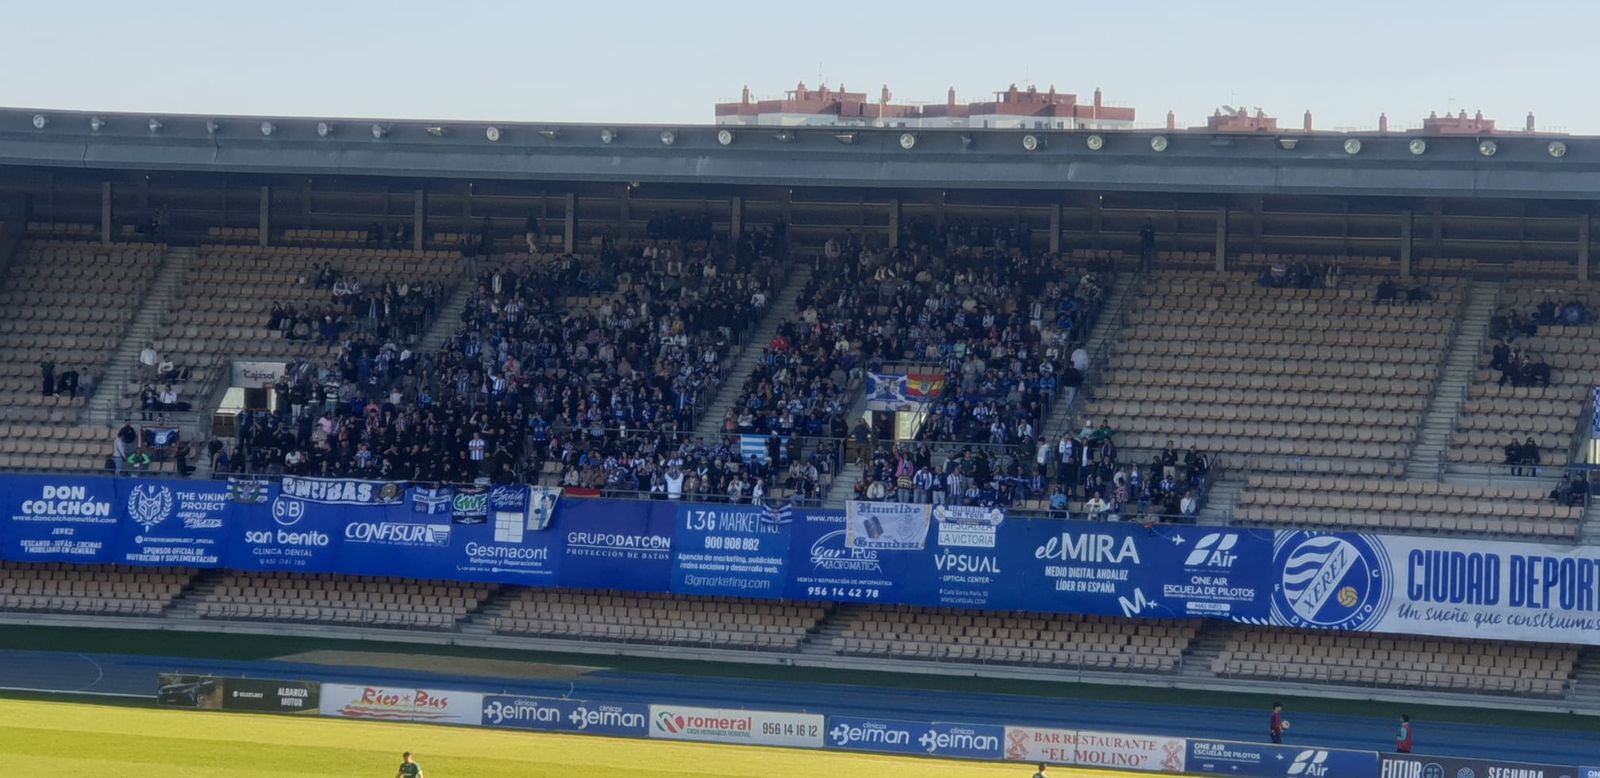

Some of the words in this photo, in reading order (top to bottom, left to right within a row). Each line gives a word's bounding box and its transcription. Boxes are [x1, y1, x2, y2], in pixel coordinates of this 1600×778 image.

[43, 486, 85, 500] DON
[176, 492, 195, 500] THE
[198, 493, 224, 502] VIKIN
[22, 496, 110, 516] COLCHÓN
[181, 502, 225, 511] PROJECT
[857, 502, 921, 516] Humilde
[245, 530, 272, 543] san
[277, 529, 328, 546] benito
[345, 522, 425, 542] CONFISUR
[939, 533, 951, 544] LA
[951, 533, 994, 546] VICTORIA
[465, 542, 548, 560] Gesmacont
[705, 536, 722, 549] 900
[724, 538, 741, 550] 908
[742, 538, 760, 551] 882
[285, 548, 312, 557] DENTAL
[566, 548, 623, 558] PROTECCIÓN
[642, 552, 669, 560] DATOS
[1207, 550, 1238, 568] Air
[1045, 566, 1067, 577] MEDIO
[1068, 567, 1095, 579] DIGITAL
[1097, 568, 1128, 581] ANDALUZ
[1191, 575, 1212, 585] ONE
[1213, 577, 1228, 586] AIR
[1304, 546, 1350, 614] XEREZ
[1407, 549, 1500, 606] CIUDAD
[808, 586, 828, 597] 956
[833, 587, 845, 597] 14
[848, 588, 862, 598] 42
[866, 589, 880, 599] 78
[1056, 578, 1076, 591] LÍDER
[1077, 581, 1086, 592] EN
[1087, 580, 1115, 593] ESPAÑA
[1163, 584, 1203, 595] ESCUELA
[1204, 587, 1217, 596] DE
[1218, 588, 1255, 598] PILOTOS
[1425, 606, 1468, 623] sueño
[1473, 612, 1503, 629] que
[281, 697, 303, 707] MOTOR
[413, 688, 448, 709] Bus
[687, 716, 752, 731] romeral
[762, 722, 781, 735] 956
[783, 724, 794, 736] 14
[808, 725, 818, 737] 12
[1034, 732, 1061, 744] BAR
[1063, 734, 1157, 751] RESTAURANTE
[1305, 764, 1328, 777] Air
